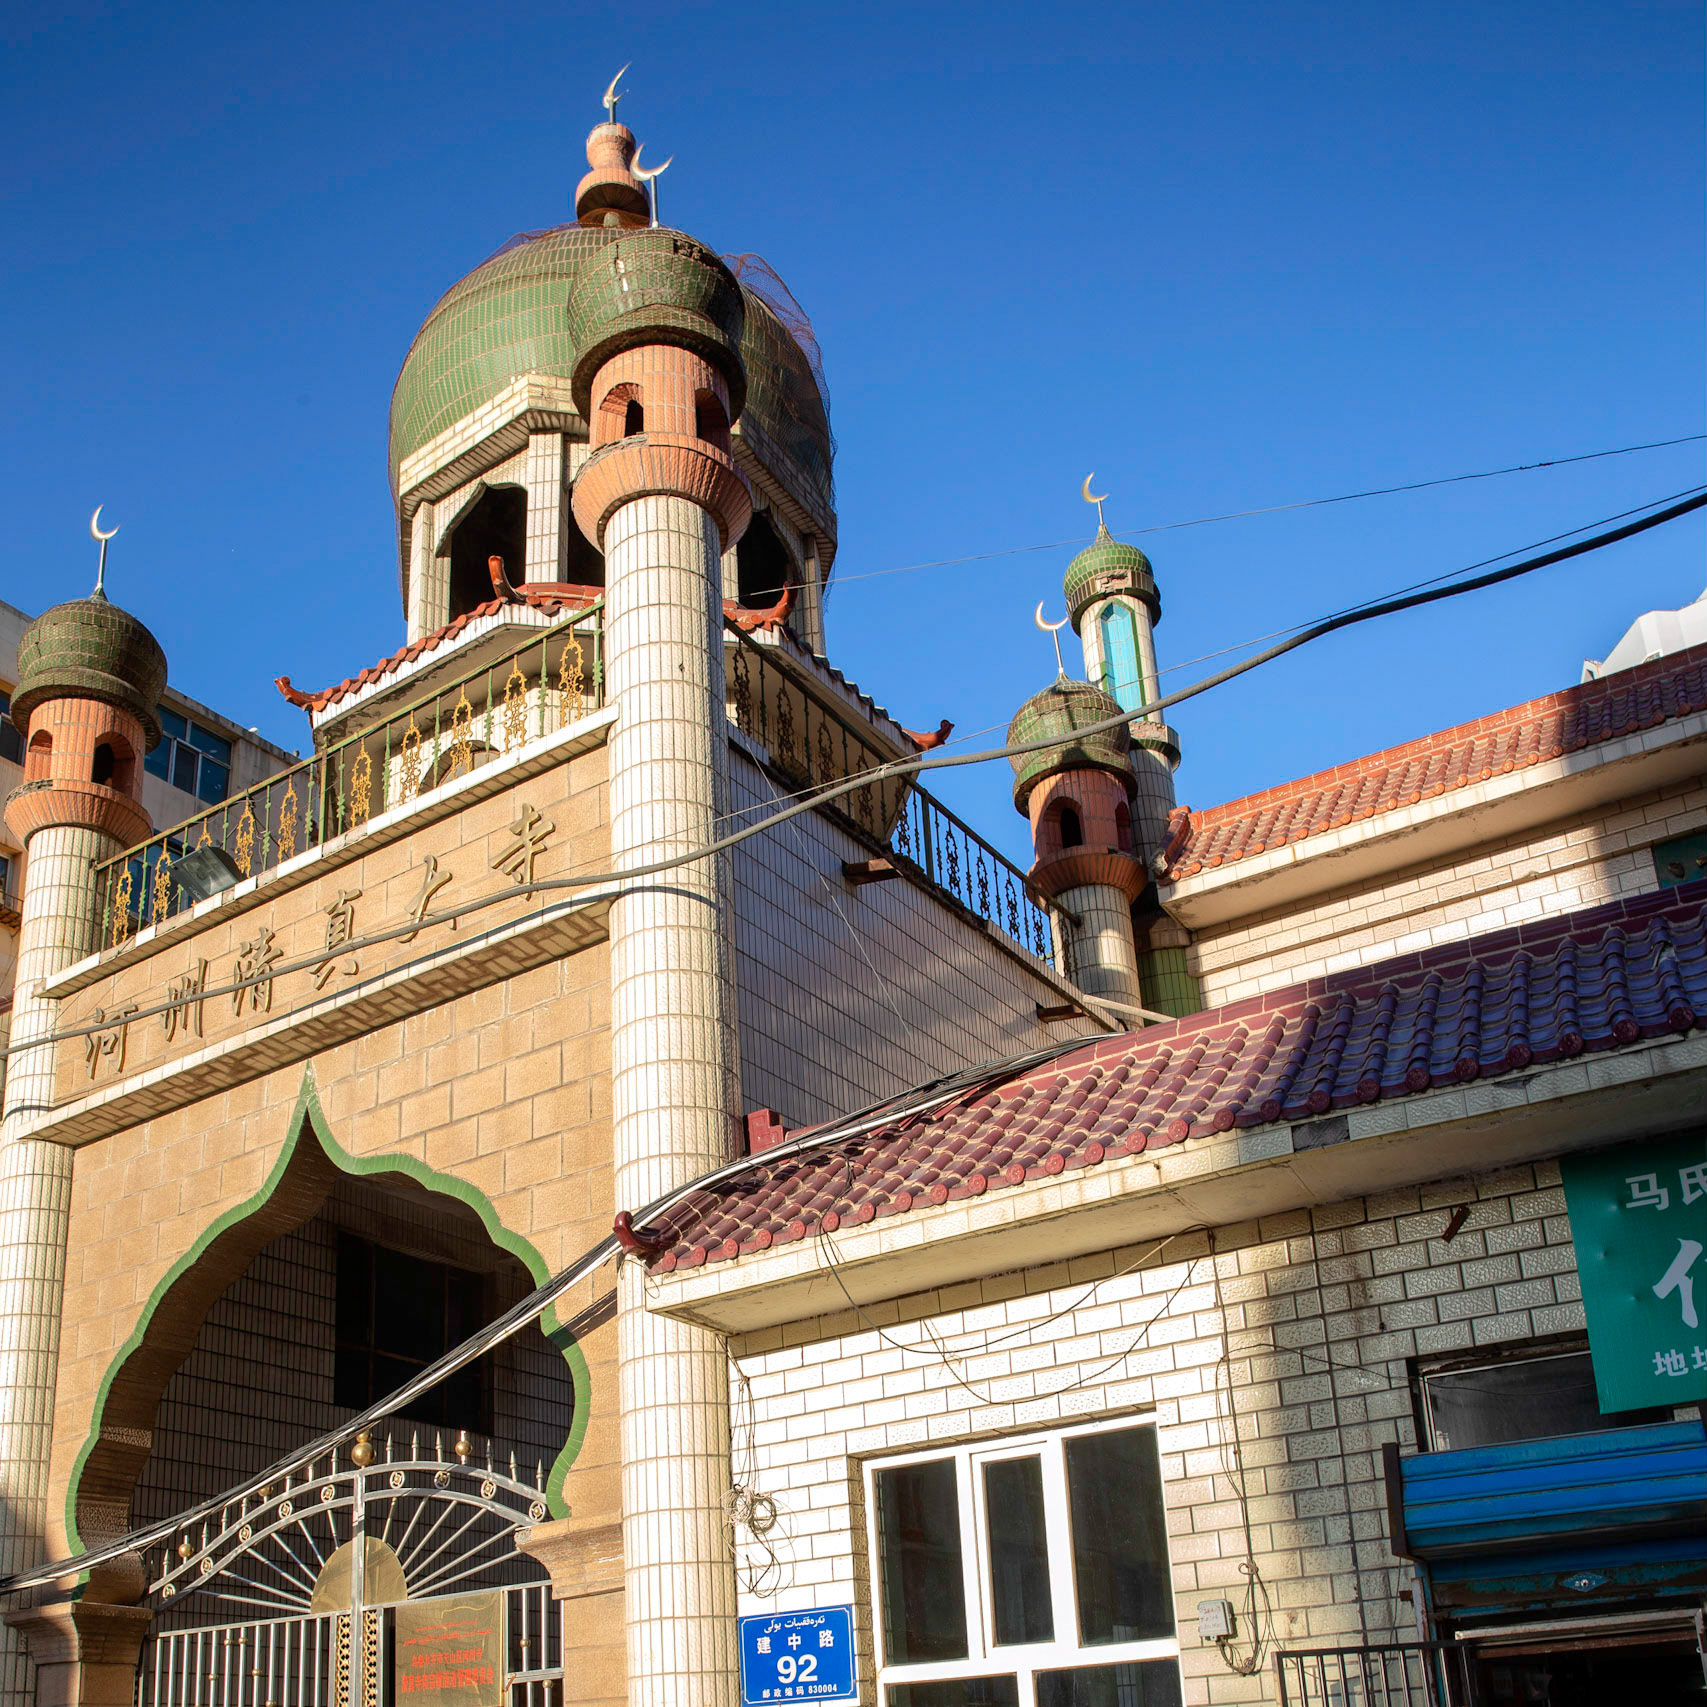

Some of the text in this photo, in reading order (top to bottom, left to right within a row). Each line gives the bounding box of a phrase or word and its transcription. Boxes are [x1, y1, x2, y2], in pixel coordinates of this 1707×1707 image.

[757, 1630, 834, 1654] 建中路
[777, 1654, 818, 1683] 92
[763, 1684, 837, 1698] 邮政编码 830004
